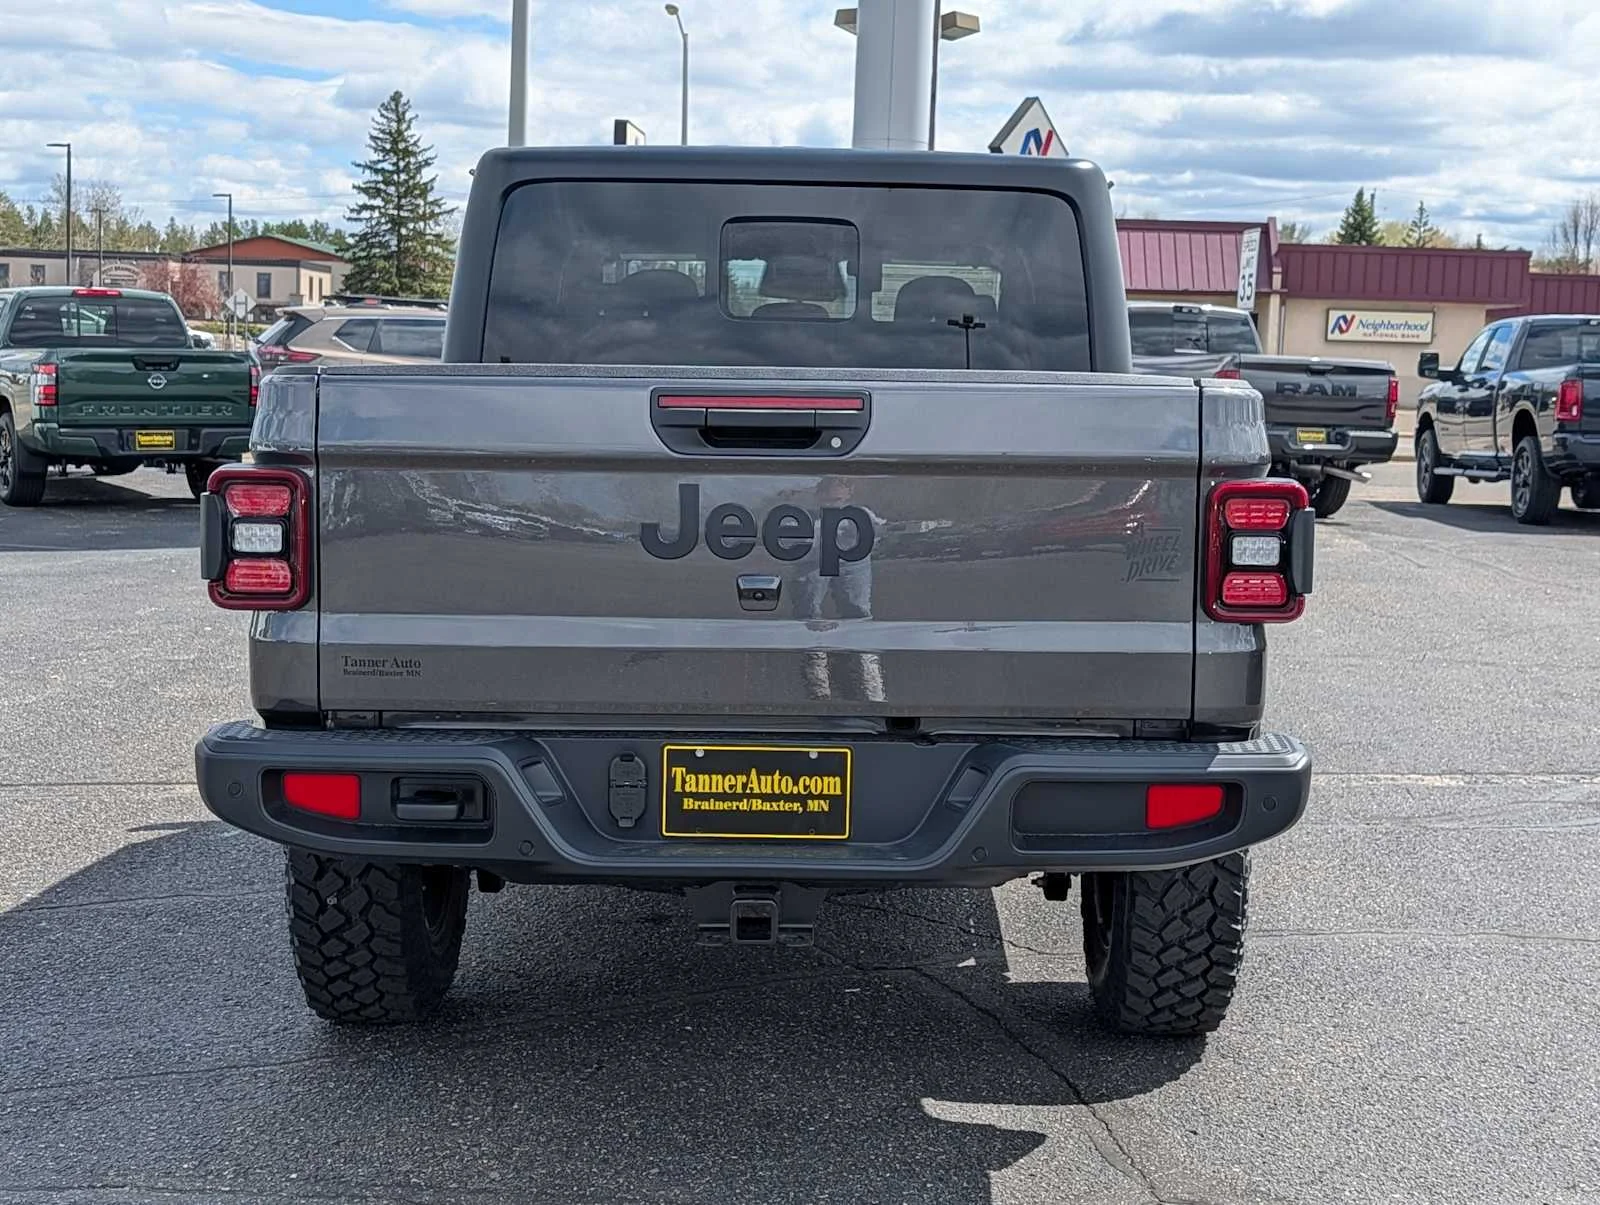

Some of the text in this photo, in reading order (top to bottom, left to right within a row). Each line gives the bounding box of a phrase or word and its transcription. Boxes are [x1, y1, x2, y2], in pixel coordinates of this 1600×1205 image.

[1240, 273, 1254, 302] 35
[1356, 318, 1430, 332] Neighborhood
[1275, 381, 1358, 397] RAM
[79, 404, 233, 416] FRONTIER
[639, 483, 875, 577] Jeep
[1126, 554, 1178, 583] DRIVE
[341, 655, 422, 669] Tanner Auto
[406, 669, 421, 677] MN
[671, 767, 842, 795] TannerAuto.com
[682, 797, 830, 813] Brainerd/Baxter, MN
